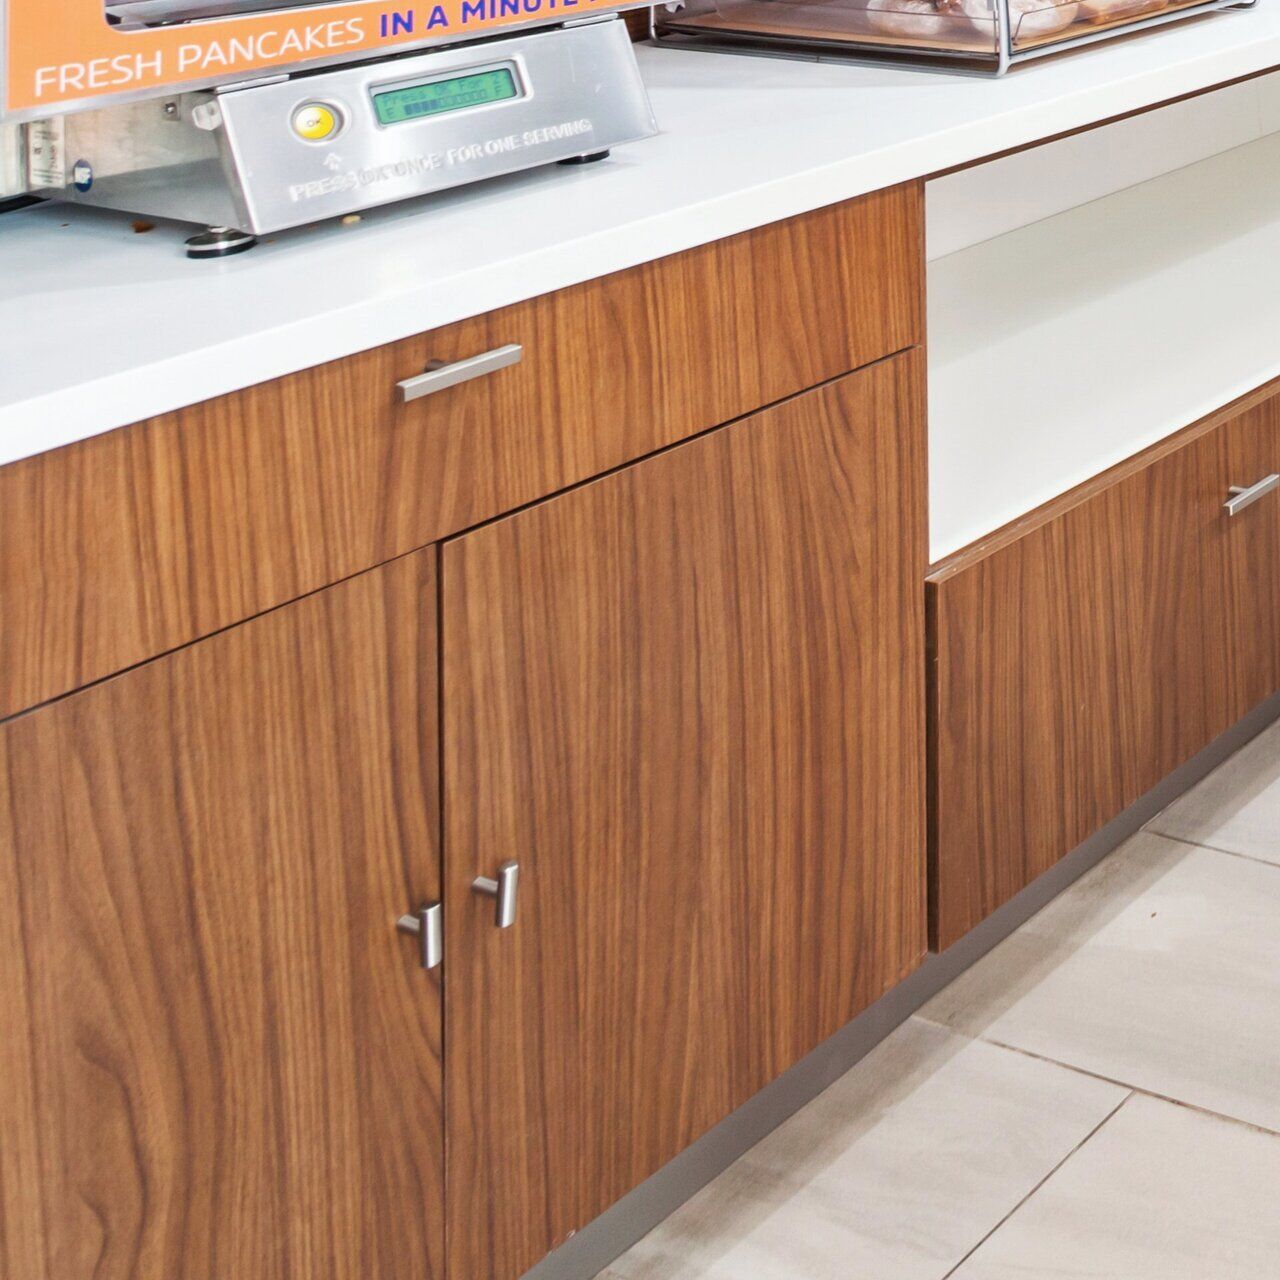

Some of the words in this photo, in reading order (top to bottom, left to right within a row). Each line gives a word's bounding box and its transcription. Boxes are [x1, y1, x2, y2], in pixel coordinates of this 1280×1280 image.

[34, 50, 162, 97] FRESH
[178, 17, 365, 72] PANCAKES
[380, 10, 414, 37] IN
[427, 5, 449, 30] A
[382, 84, 425, 107] Press
[306, 118, 322, 128] OK
[446, 143, 485, 166] FOR
[485, 133, 522, 155] ONE
[523, 119, 592, 146] SERVING
